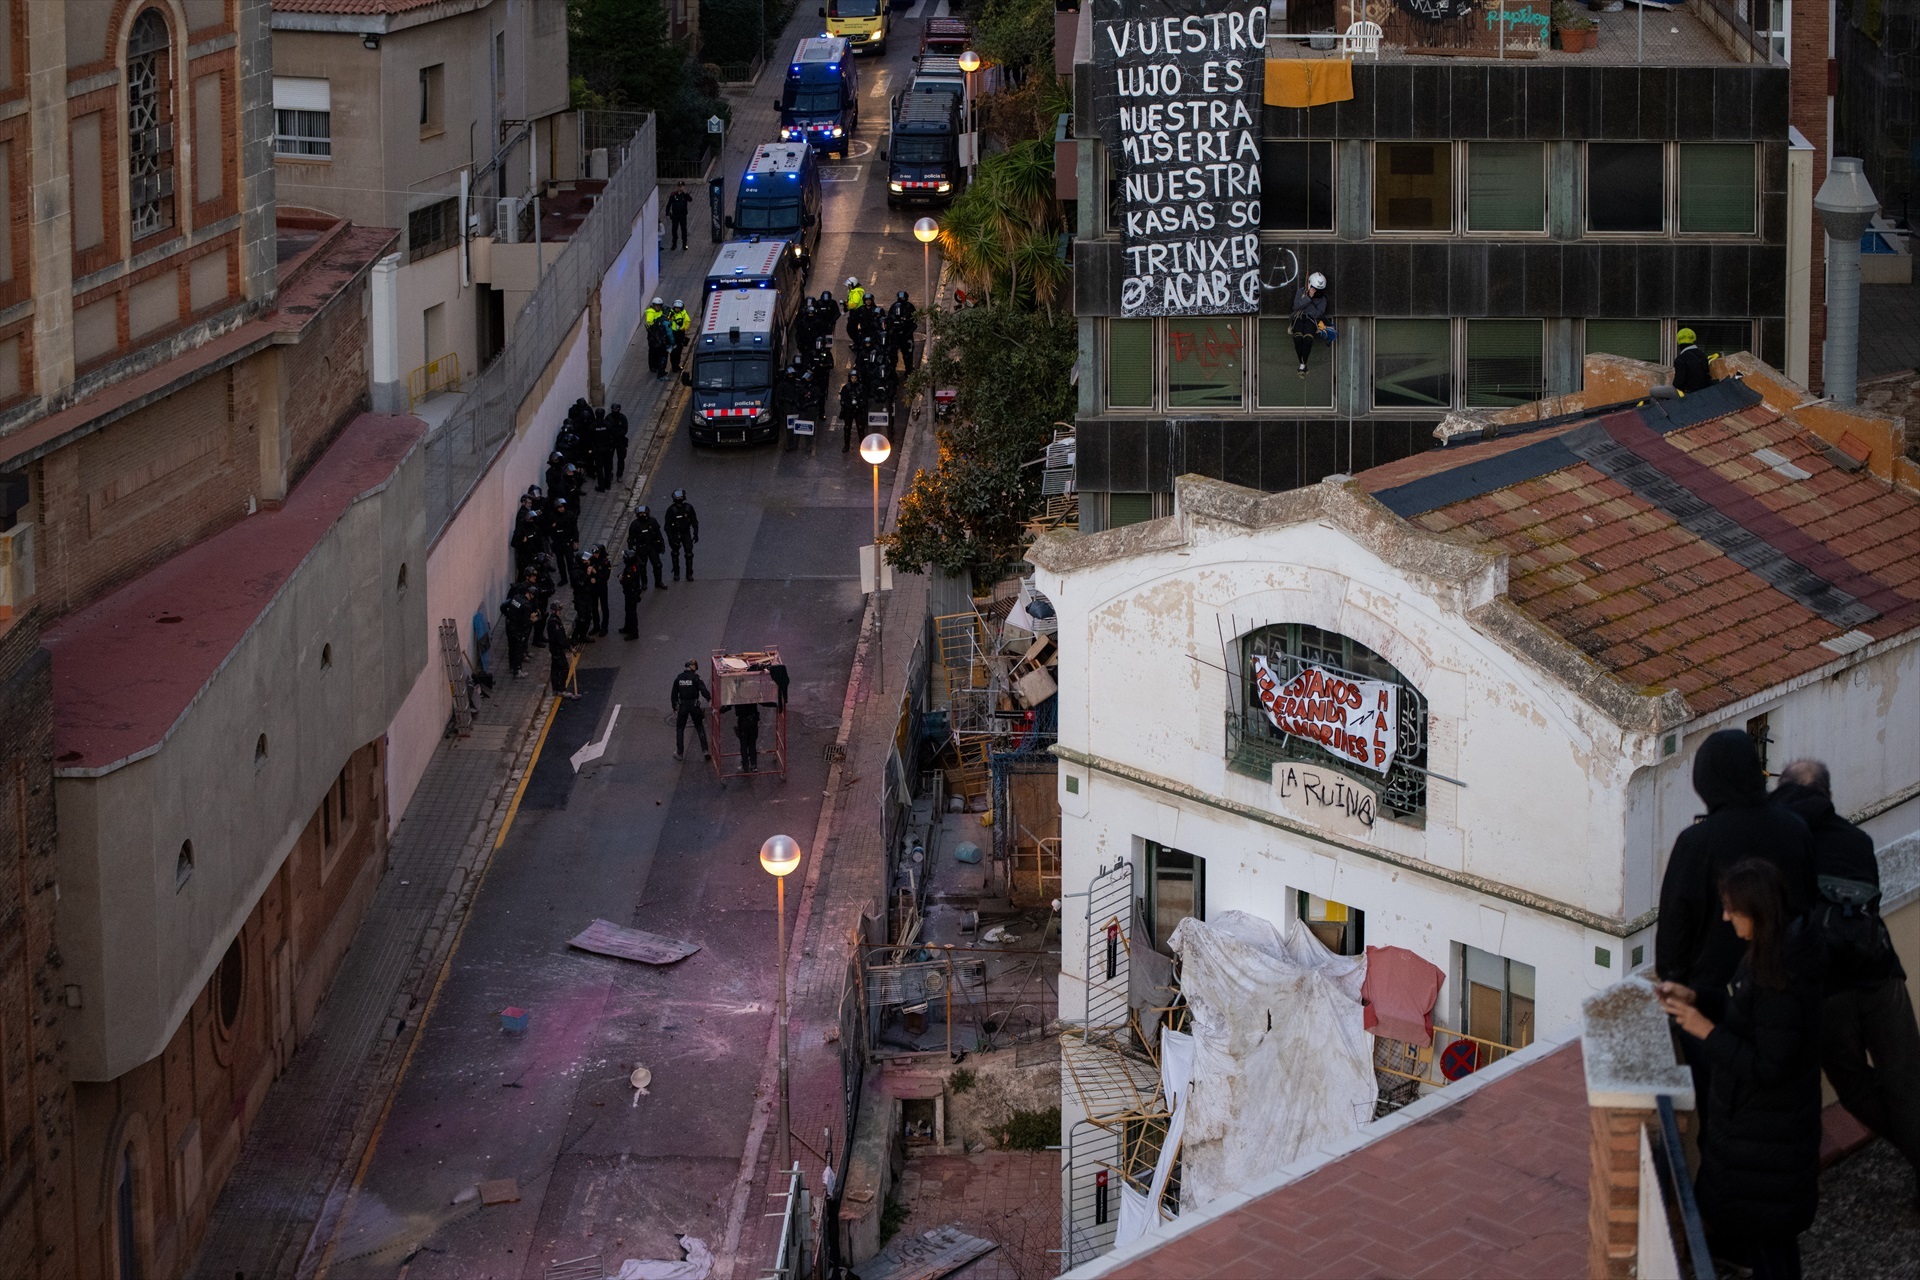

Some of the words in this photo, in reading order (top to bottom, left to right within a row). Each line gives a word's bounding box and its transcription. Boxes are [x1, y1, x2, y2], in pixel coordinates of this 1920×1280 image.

[1107, 6, 1266, 57] VUESTRO
[1117, 63, 1181, 97] LUJO
[1203, 60, 1243, 93] ES
[1120, 99, 1253, 133] NUESTRA
[1122, 130, 1260, 164] MISERIA
[1126, 164, 1261, 203] NUESTRA
[1127, 201, 1215, 237] KASAS
[1227, 201, 1261, 228] SO
[1126, 234, 1260, 275] TRINXER
[1281, 768, 1298, 798] LA
